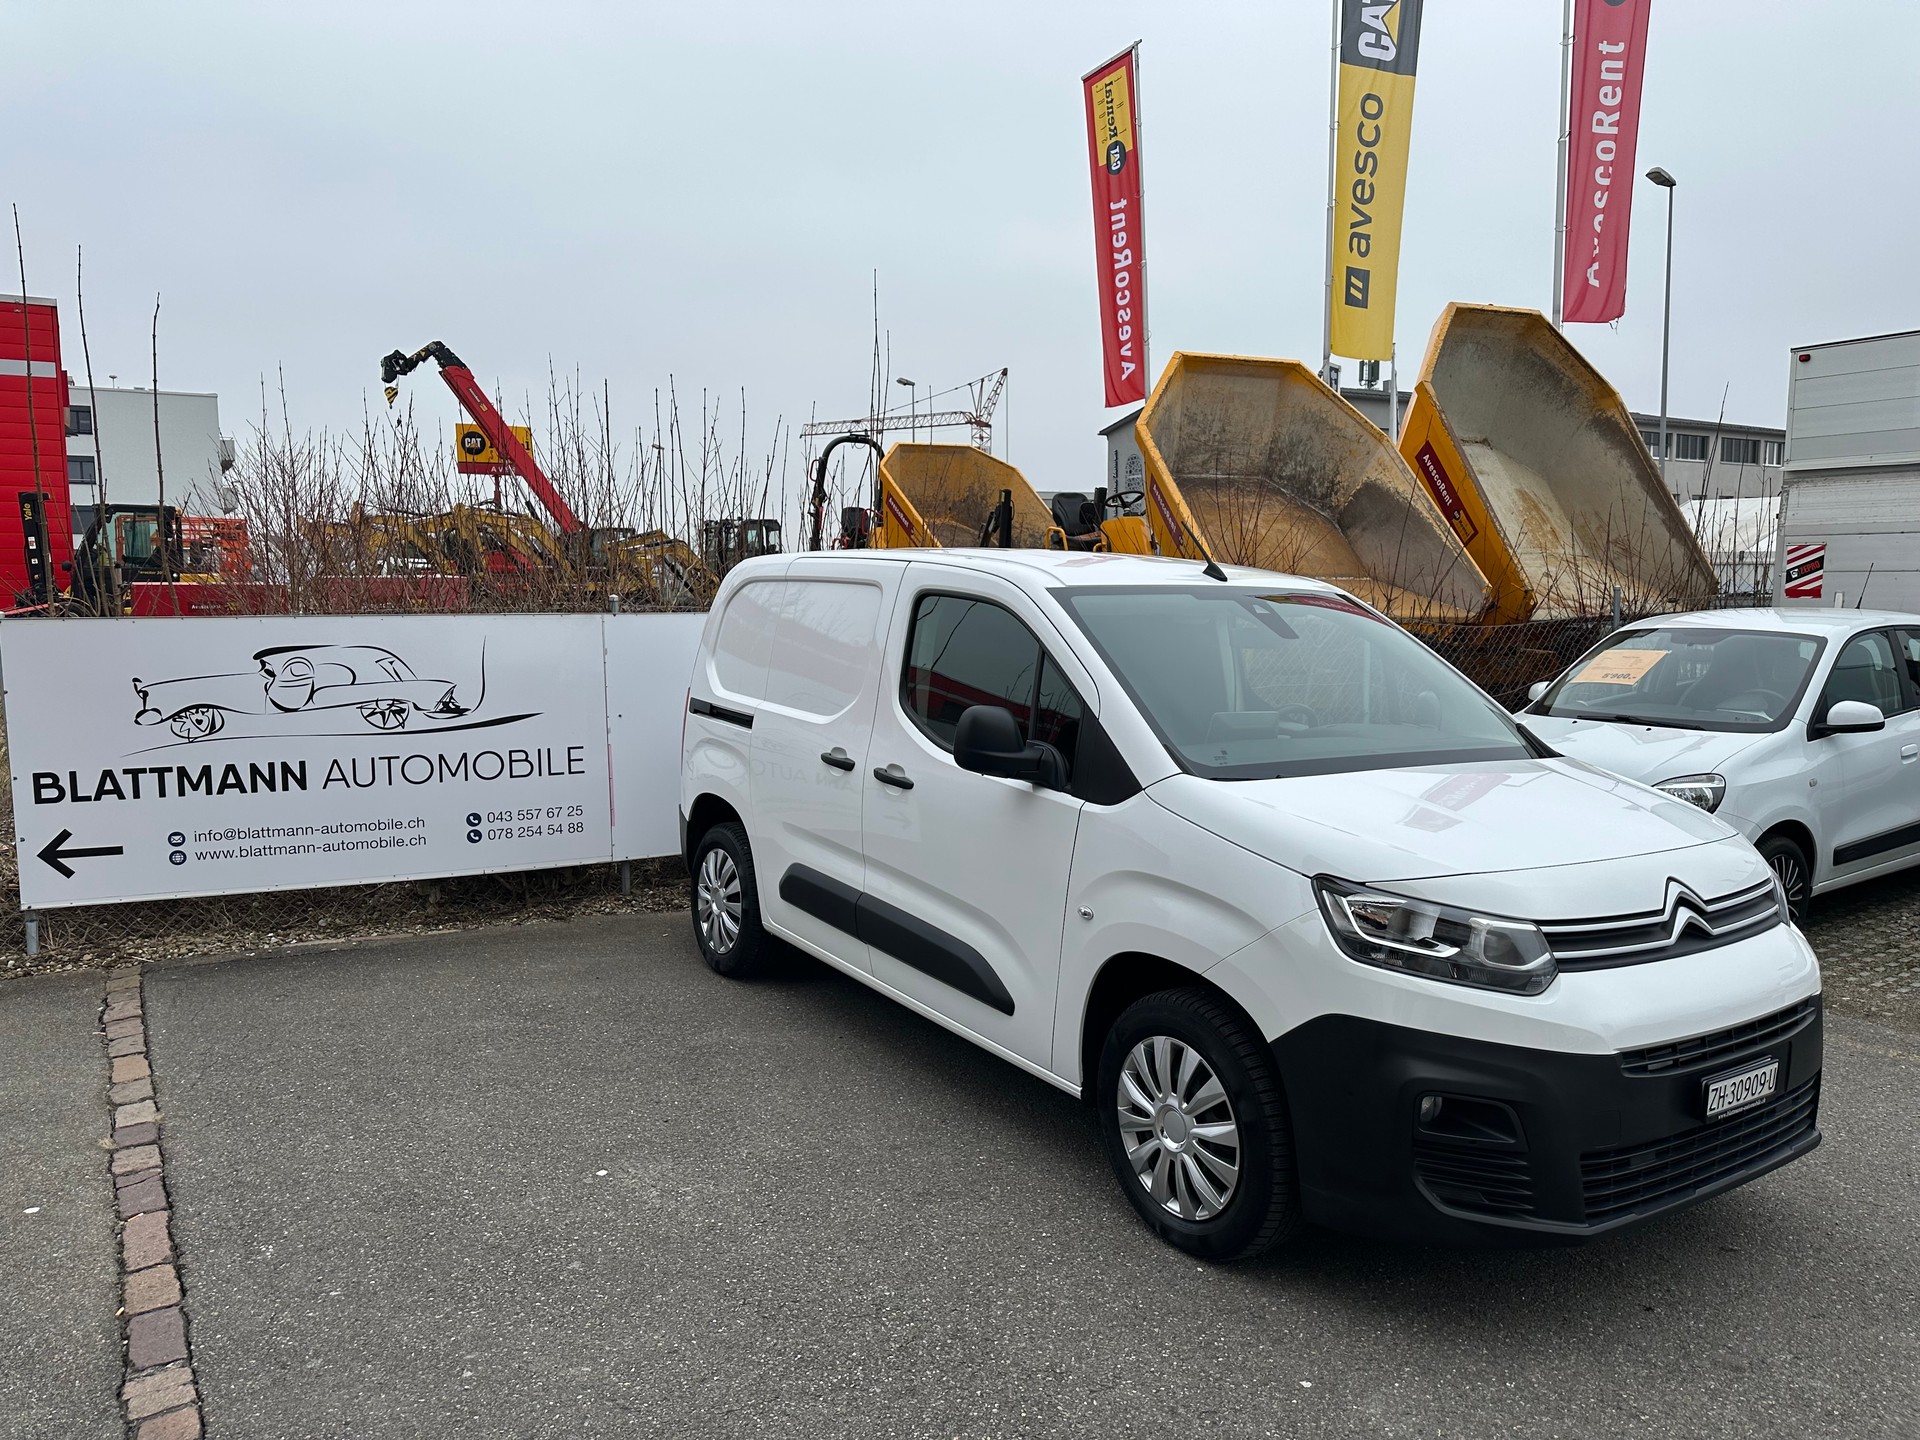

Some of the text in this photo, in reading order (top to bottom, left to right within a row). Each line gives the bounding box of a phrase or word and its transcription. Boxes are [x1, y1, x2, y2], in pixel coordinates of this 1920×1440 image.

[1358, 0, 1400, 62] CA
[1348, 92, 1384, 258] avesco
[465, 437, 481, 448] CAT
[1422, 454, 1453, 507] AvescoRent
[24, 502, 33, 521] Yale
[33, 745, 586, 805] BLATTMANN AUTOMOBILE
[487, 804, 584, 823] 043 557 67 25
[194, 816, 425, 843] info@blattmann-automobile.ch
[487, 821, 584, 841] 078 254 54 88
[195, 834, 427, 861] www.blattmann-automobile.ch
